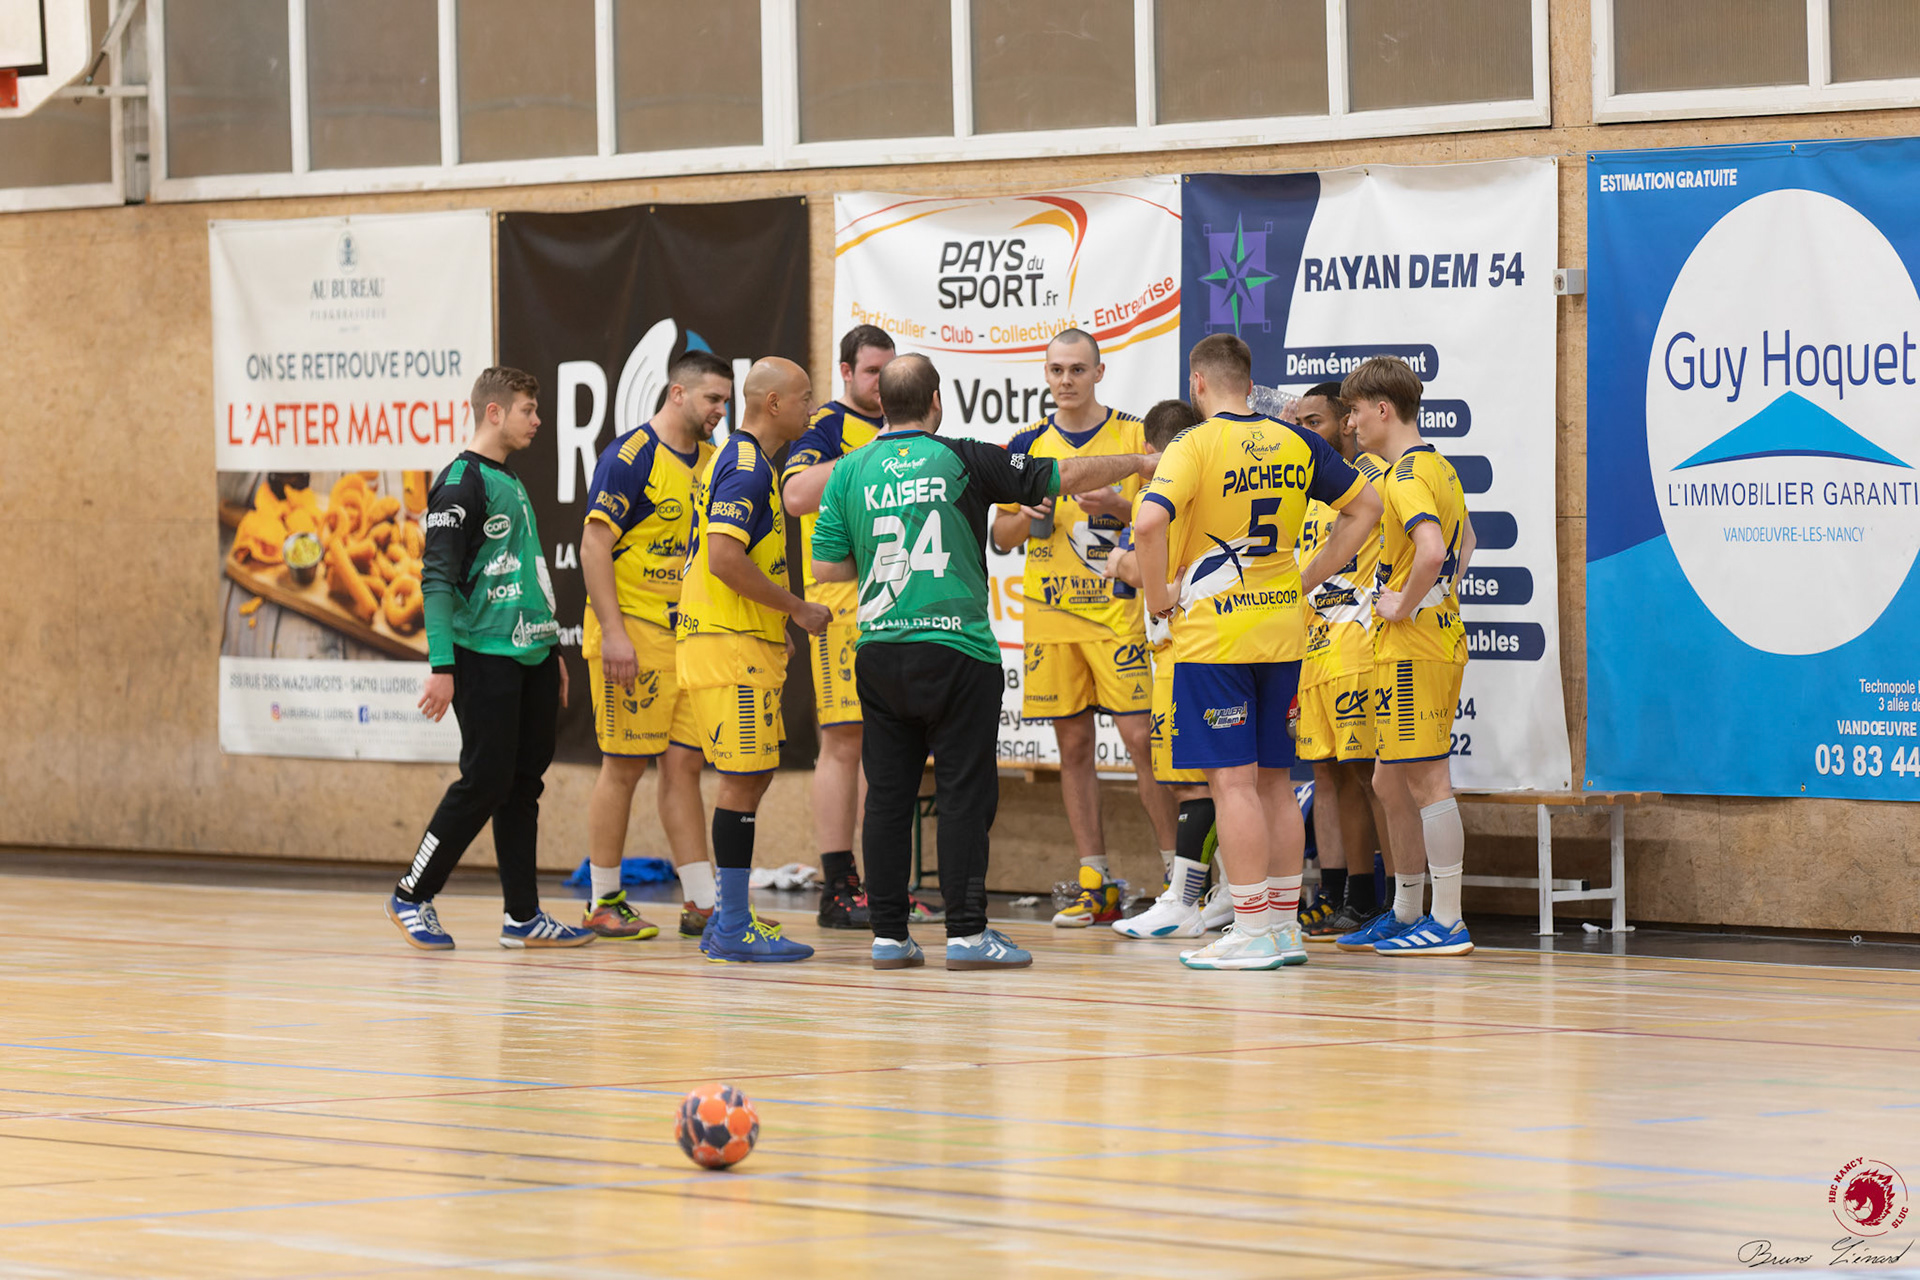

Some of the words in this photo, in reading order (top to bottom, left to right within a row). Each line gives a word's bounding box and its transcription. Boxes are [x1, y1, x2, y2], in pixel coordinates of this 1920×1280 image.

[1600, 171, 1675, 192] ESTIMATION
[1676, 168, 1738, 189] GRATUITE
[939, 239, 1026, 274] PAYS
[1027, 254, 1044, 272] du
[1304, 254, 1401, 293] RAYAN
[1408, 253, 1479, 290] DEM
[1488, 252, 1525, 288] 54
[310, 279, 327, 299] AU
[331, 278, 385, 299] BUREAU
[851, 301, 926, 339] Particulier
[941, 325, 974, 344] Club
[990, 314, 1078, 344] Collectivité
[1094, 275, 1176, 328] Entreprise
[247, 354, 273, 381] ON
[277, 353, 297, 380] SE
[302, 351, 399, 379] RETROUVE
[404, 350, 461, 378] POUR
[1665, 331, 1747, 402] Guy
[1763, 329, 1917, 400] Hoquet
[228, 403, 340, 446] L'AFTER
[1418, 407, 1458, 429] iano
[864, 476, 948, 511] KAISER
[1222, 464, 1306, 498] PACHECO
[1668, 482, 1814, 506] L'IMMOBILIER
[1823, 481, 1919, 506] GARANTI
[659, 505, 681, 514] cora
[1242, 497, 1283, 557] 5
[1723, 526, 1865, 543] VANDOEUVRE-LES-NANCY
[555, 543, 578, 569] LA
[1233, 590, 1297, 606] MILDECOR
[1459, 574, 1499, 596] rise
[1859, 679, 1916, 696] Technopole
[1878, 697, 1885, 711] 3
[1887, 697, 1909, 712] allée
[1815, 744, 1845, 775] 03
[1852, 745, 1883, 777] 83
[1891, 746, 1920, 778] 44
